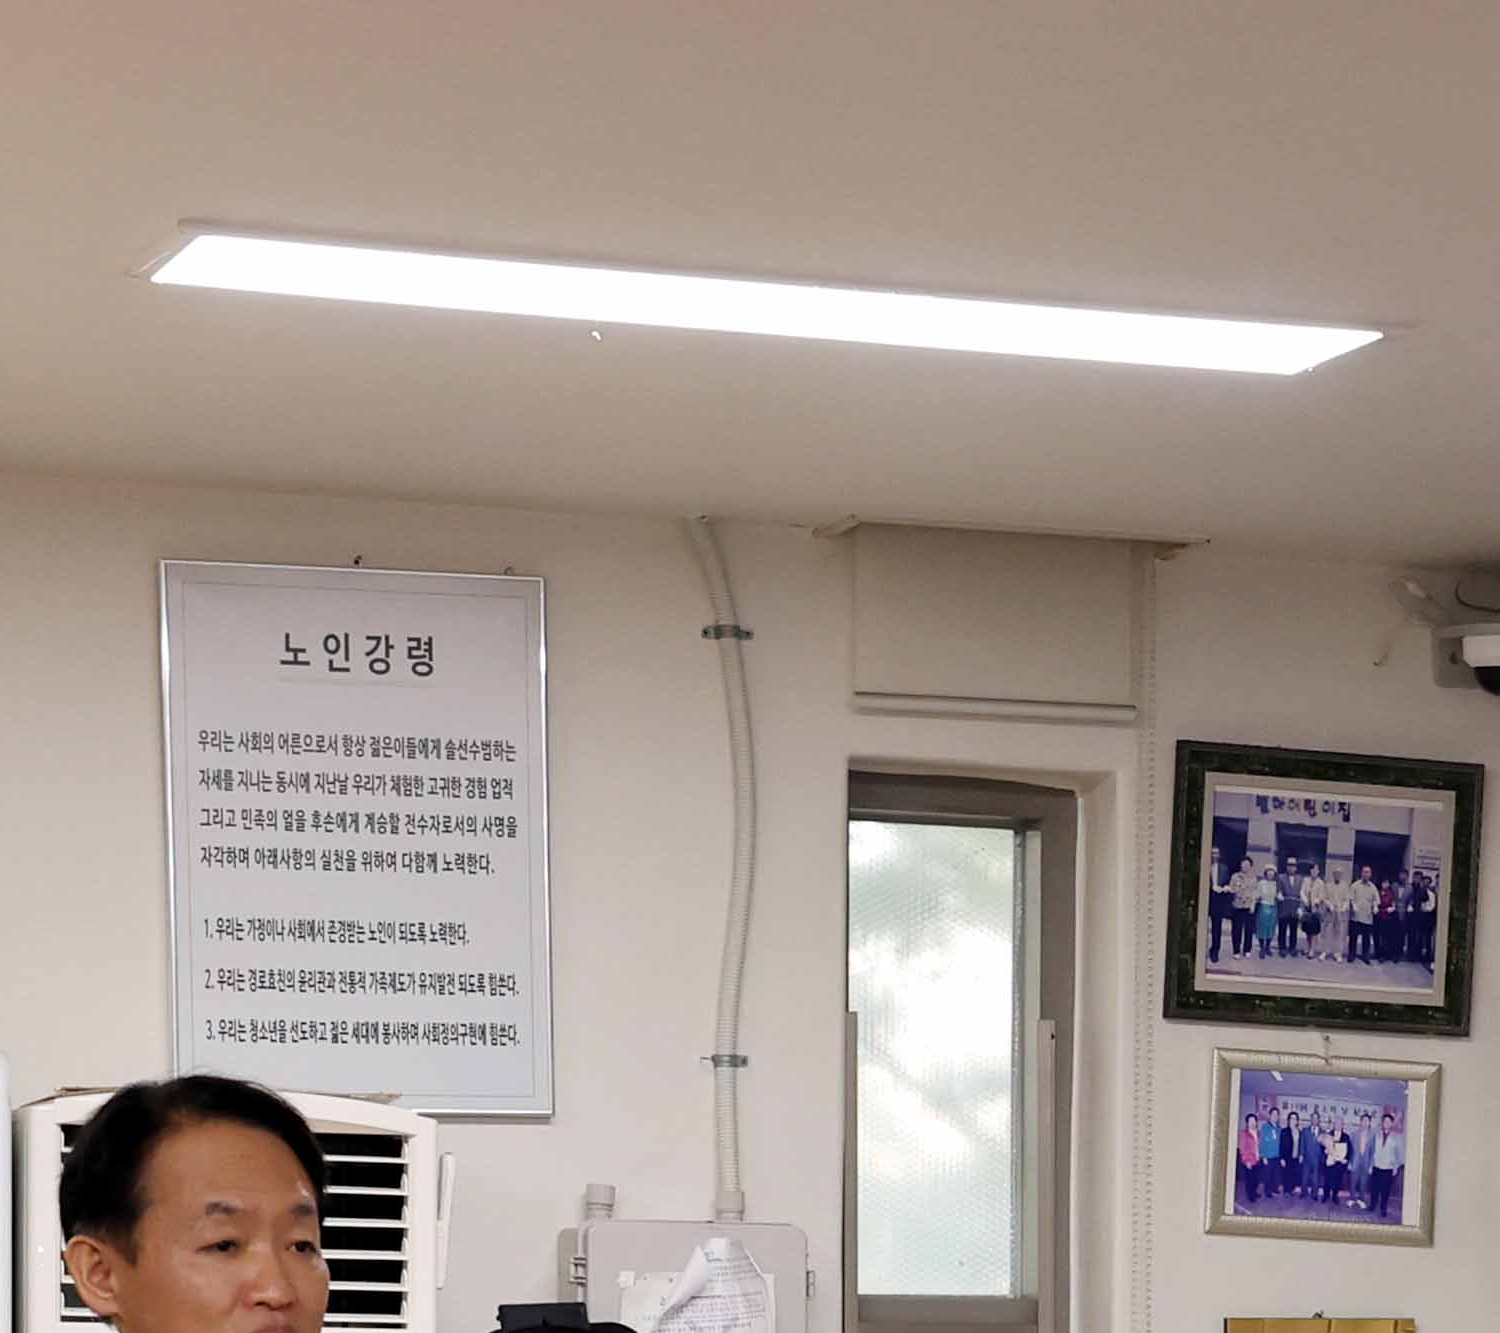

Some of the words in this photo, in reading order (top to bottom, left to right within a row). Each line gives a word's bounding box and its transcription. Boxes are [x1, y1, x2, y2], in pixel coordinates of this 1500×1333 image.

[280, 632, 436, 677] 노인강령
[198, 730, 234, 753] 우리는
[237, 731, 274, 754] 사회의
[278, 732, 339, 756] 어른으로서
[343, 734, 366, 757] 항상
[369, 736, 441, 759] 젊은이들에게
[444, 738, 517, 762] 솔선수범하는
[198, 768, 234, 791] 자세를
[237, 770, 273, 793] 지니는
[275, 771, 310, 794] 동시에
[314, 772, 349, 795] 지난날
[352, 774, 387, 796] 우리가
[427, 776, 462, 799] 고귀한
[464, 777, 487, 800] 경험
[490, 778, 513, 800] 업적
[200, 808, 236, 829] 그리고
[241, 808, 278, 831] 민족의
[282, 809, 306, 832] 얼을
[311, 810, 360, 834] 후손에게
[364, 812, 400, 835] 계승할
[481, 815, 517, 838] 사명을
[200, 846, 250, 869] 자각하며
[254, 847, 316, 870] 아래사항의
[320, 849, 357, 872] 실천을
[361, 850, 397, 873] 위하여
[401, 852, 438, 874] 다함께
[442, 853, 495, 876] 노력한다.
